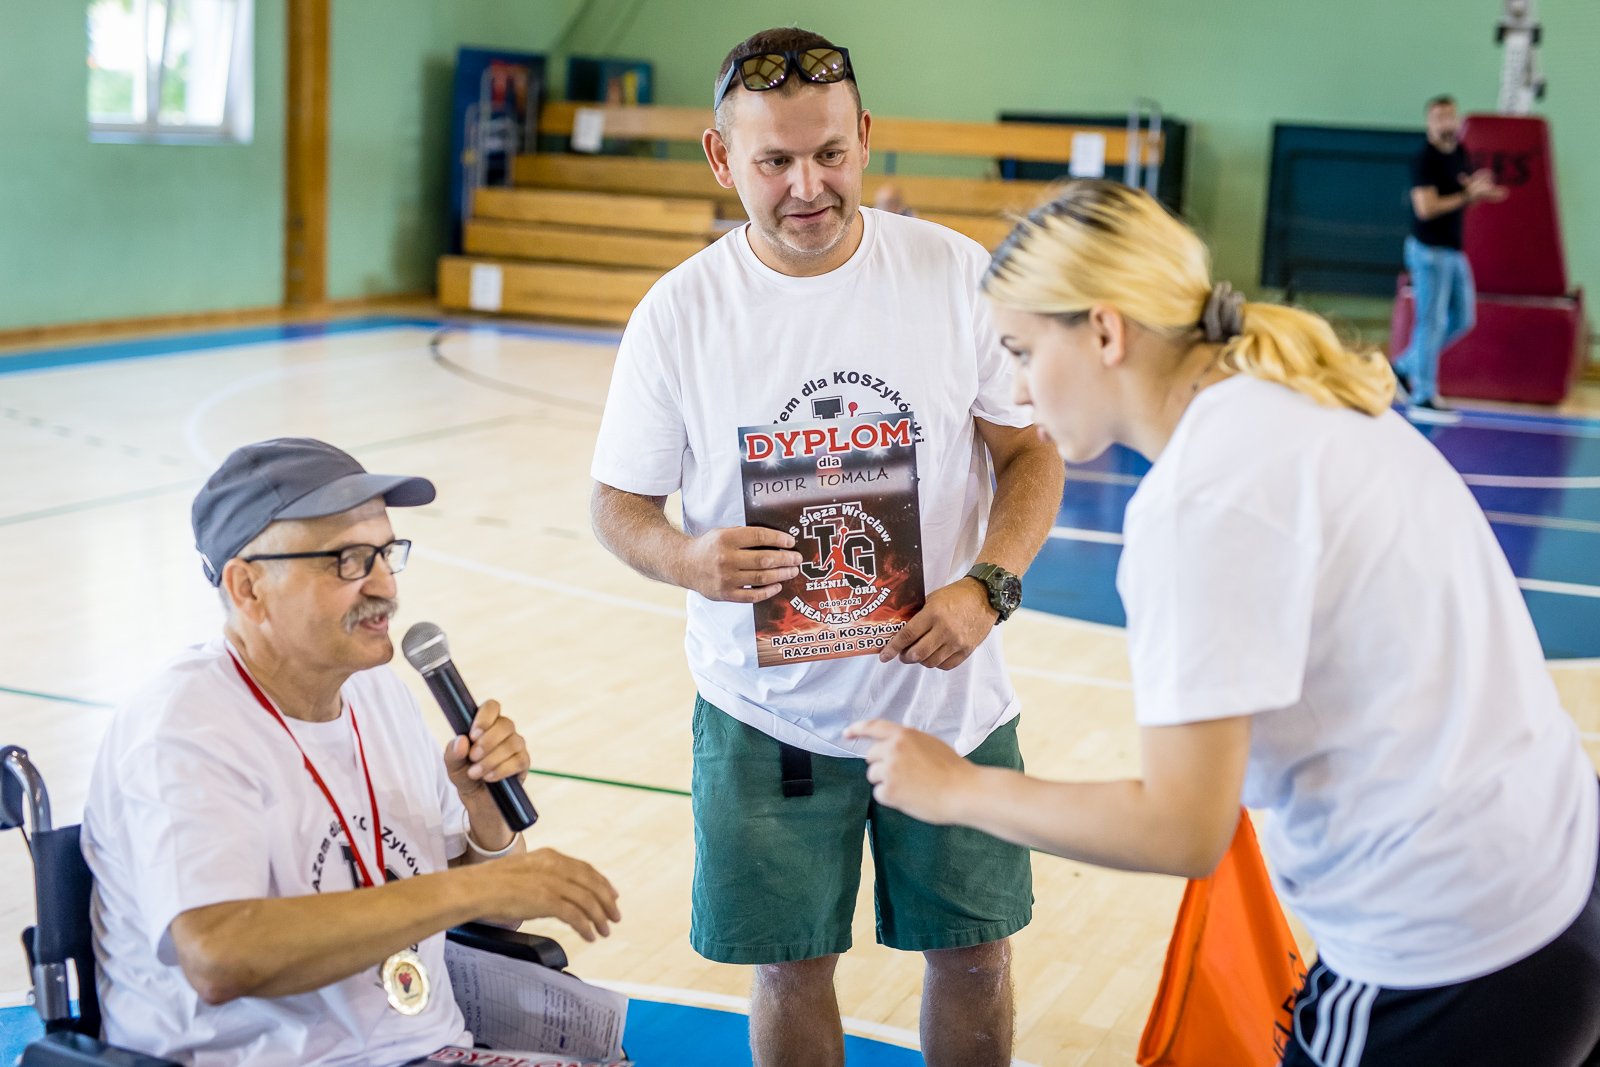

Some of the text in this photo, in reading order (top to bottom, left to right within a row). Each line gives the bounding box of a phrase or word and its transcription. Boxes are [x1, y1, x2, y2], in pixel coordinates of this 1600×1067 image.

[801, 377, 828, 397] dla
[833, 371, 925, 443] KOSZykóki
[746, 419, 911, 461] DYPLOM
[818, 457, 841, 468] dla
[752, 467, 889, 496] PIOTR TOMALA
[799, 507, 837, 527] Ślęza
[841, 504, 892, 543] Wrocław
[789, 586, 891, 624] ENEA AZS Poznań
[819, 597, 861, 609] 04.09.2021
[772, 621, 906, 647] RAZem dla KOSZyków
[784, 637, 892, 658] RAZem dla SPOr
